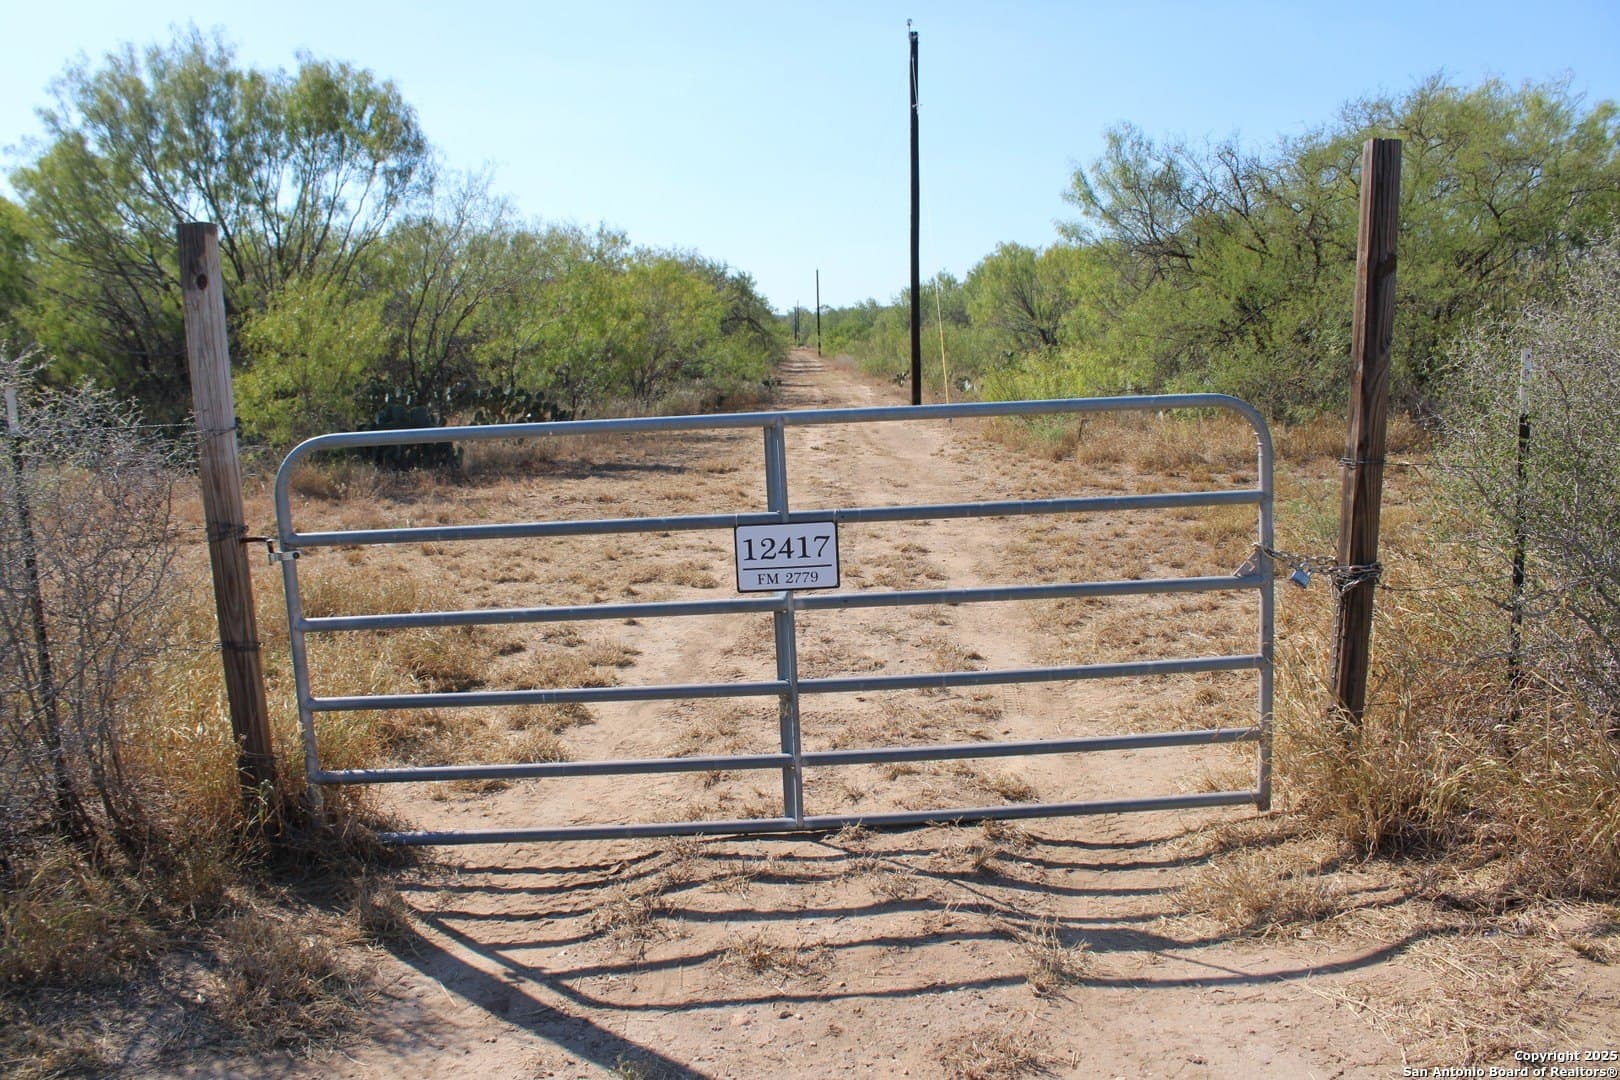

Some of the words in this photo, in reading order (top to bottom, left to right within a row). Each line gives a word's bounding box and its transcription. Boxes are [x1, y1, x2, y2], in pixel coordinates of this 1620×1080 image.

[743, 535, 831, 561] 12417
[757, 573, 779, 585] FM
[785, 571, 819, 584] 2779
